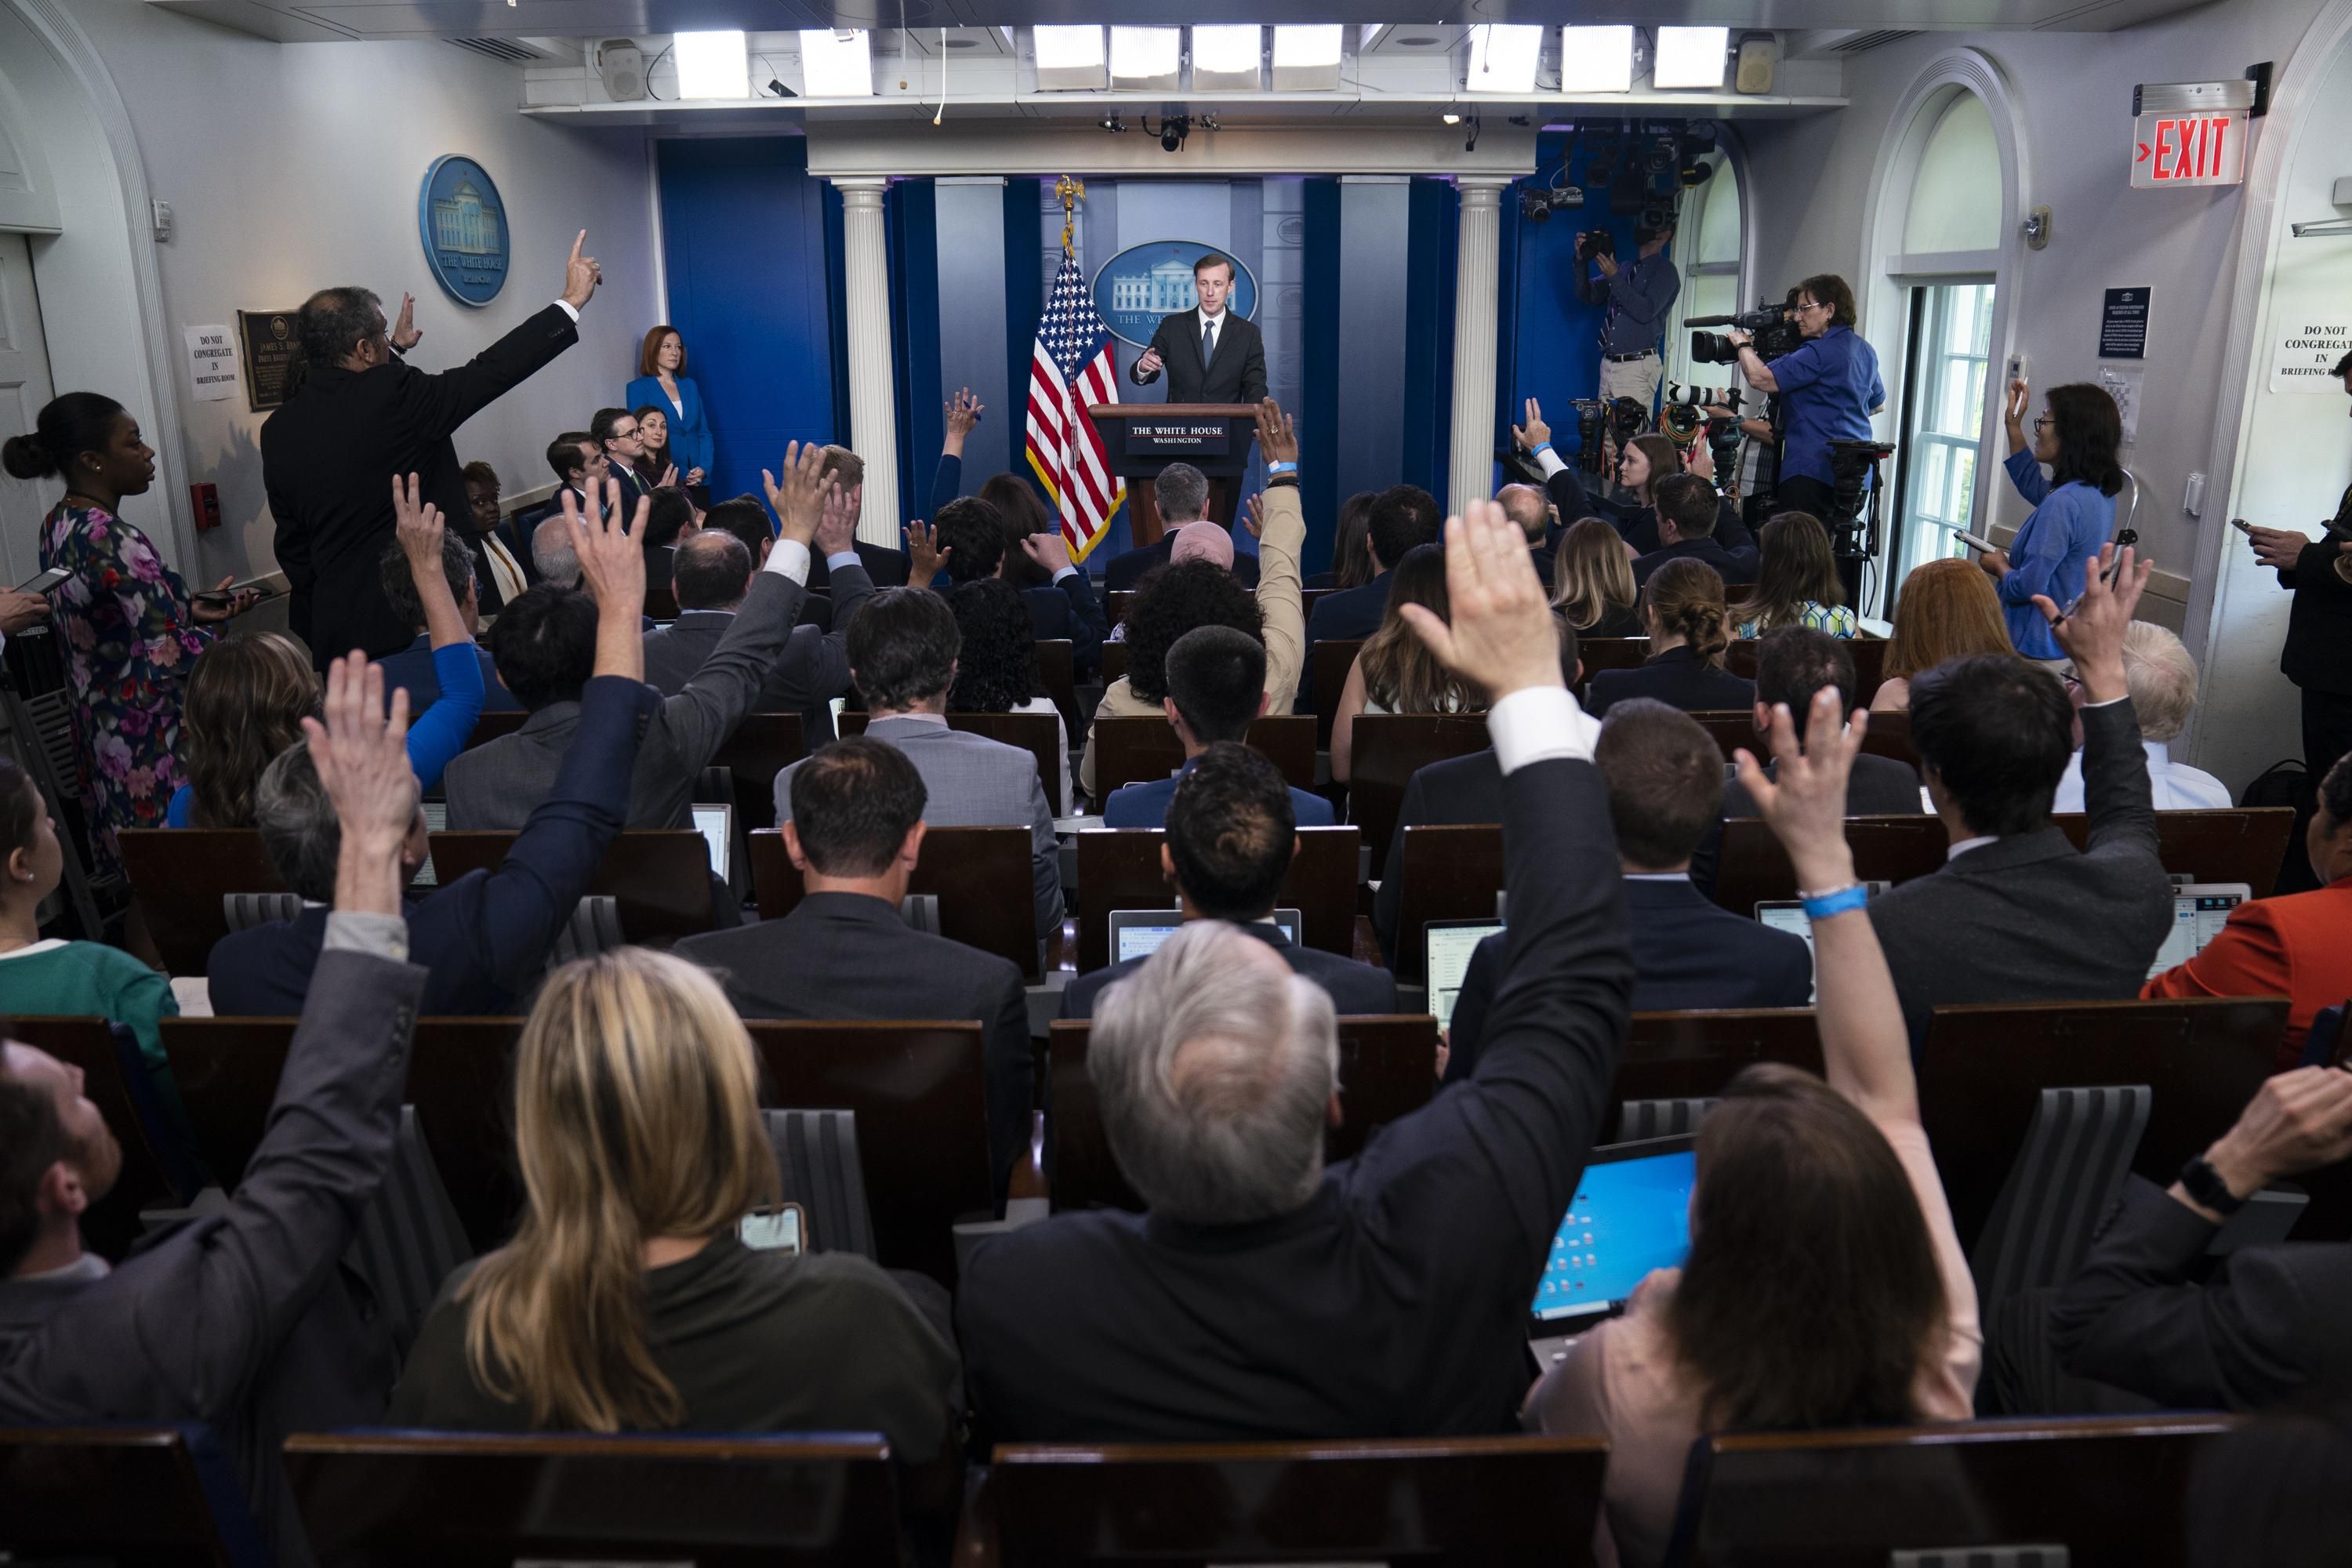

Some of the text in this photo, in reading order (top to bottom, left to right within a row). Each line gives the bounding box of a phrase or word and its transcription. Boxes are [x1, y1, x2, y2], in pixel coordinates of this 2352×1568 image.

[2152, 117, 2230, 180] EXIT
[444, 255, 502, 269] THE WHITE HOUSE
[1117, 314, 1142, 324] THE
[2304, 326, 2347, 335] DO NOT
[200, 335, 223, 345] DO NOT
[2285, 339, 2352, 349] CONGREGAT
[194, 348, 233, 358] CONGREGATE
[2314, 354, 2328, 363] IN
[212, 361, 219, 371] IN
[197, 374, 235, 384] BRIEFING ROOM
[1132, 426, 1223, 435] THE WHITE HOUSE
